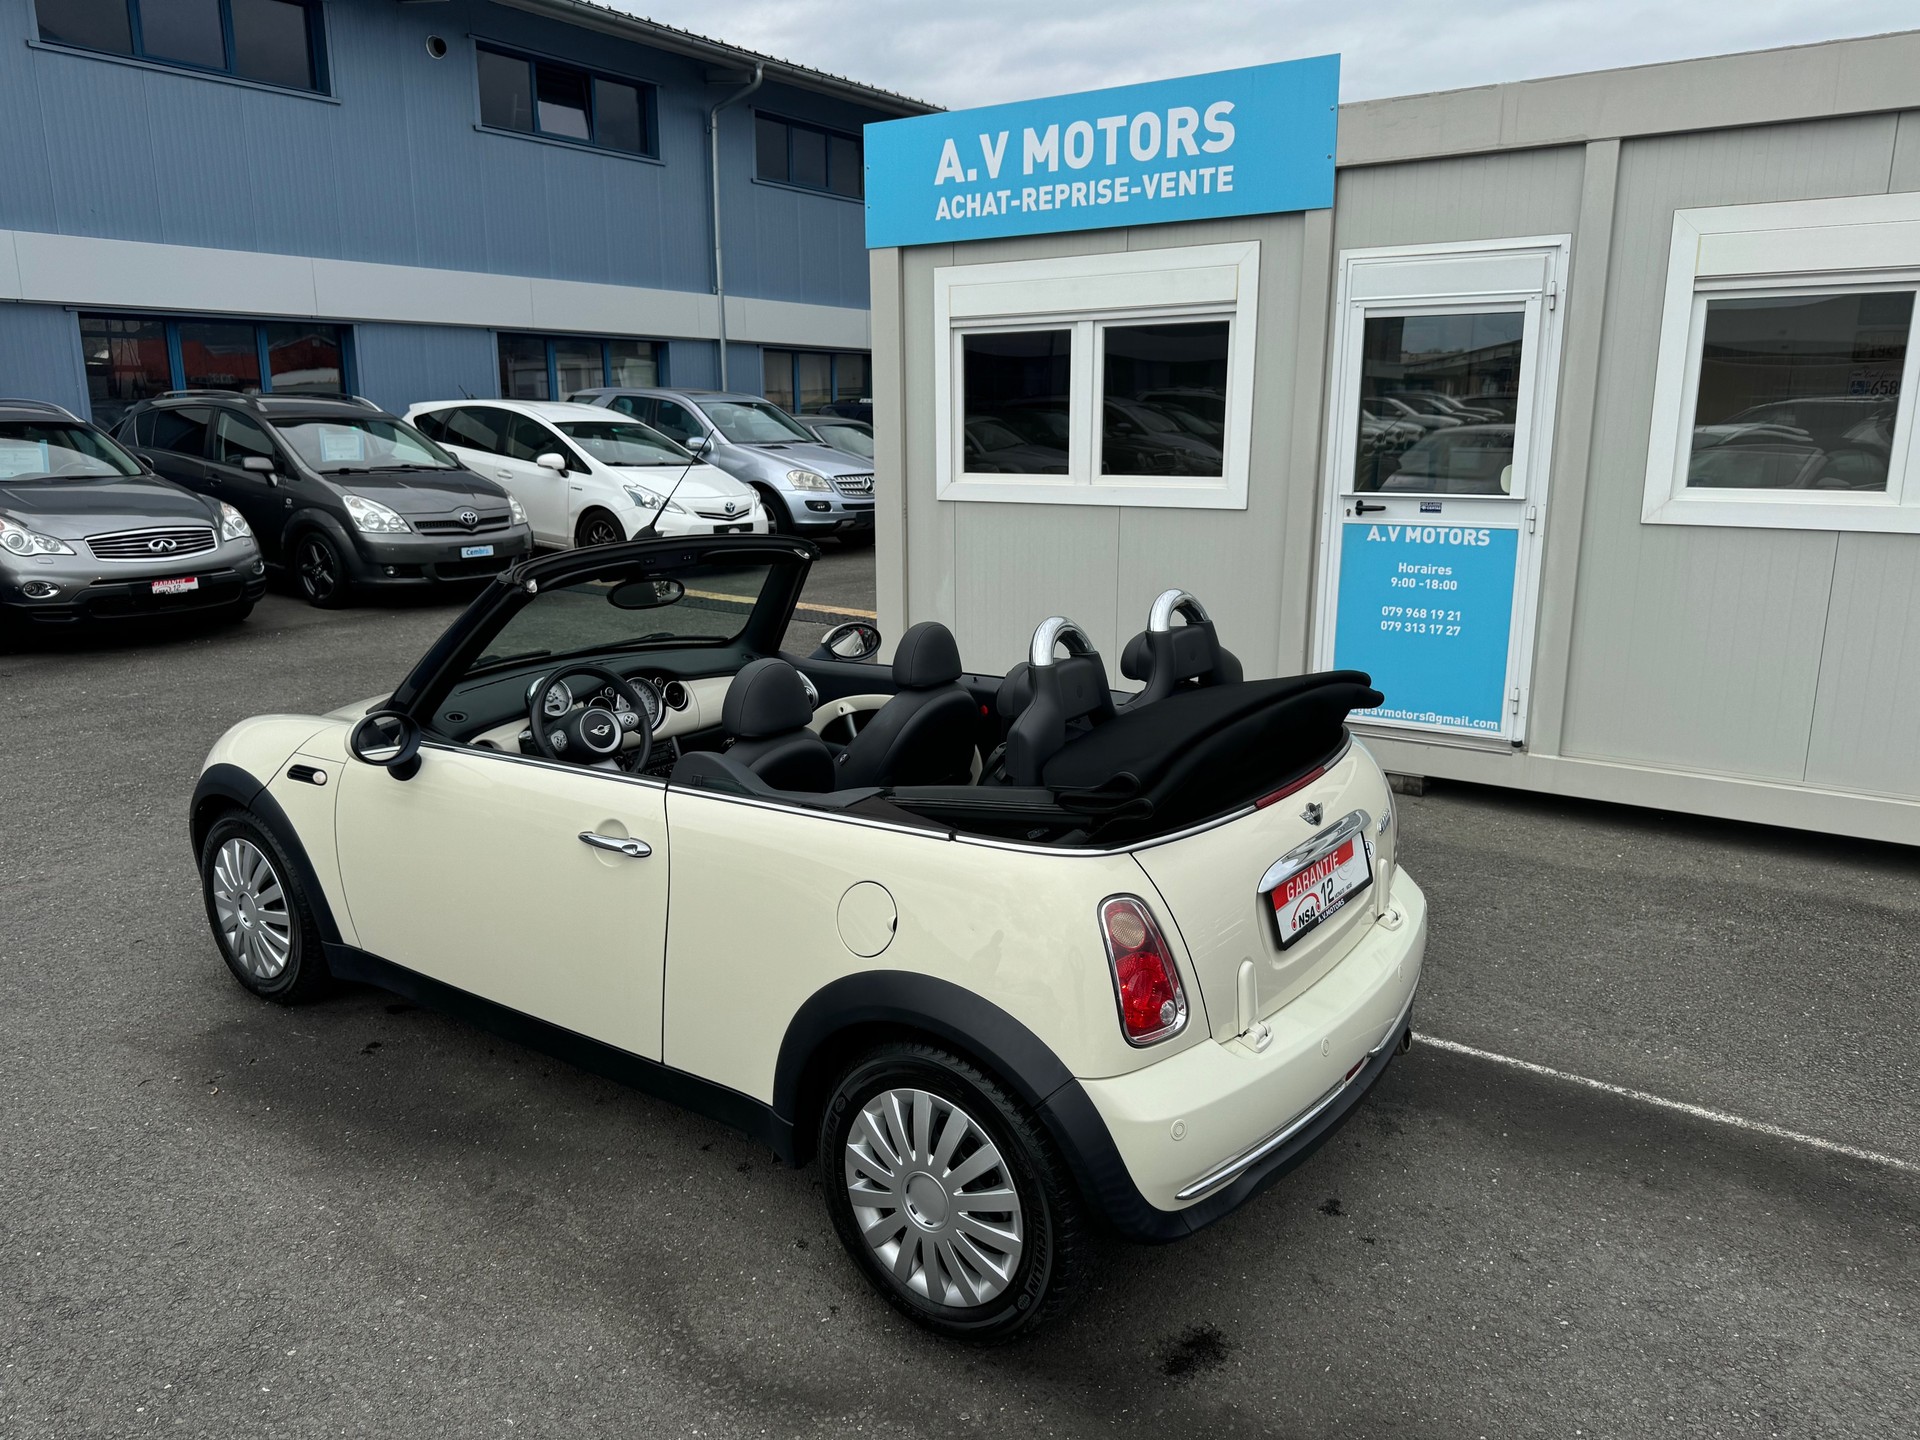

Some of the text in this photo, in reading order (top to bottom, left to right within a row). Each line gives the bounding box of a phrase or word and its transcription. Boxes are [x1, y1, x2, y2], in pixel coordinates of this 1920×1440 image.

[934, 101, 1235, 185] A.V MOTORS
[935, 165, 1234, 221] ACHAT-REPRISE-VENTE
[1366, 525, 1491, 546] A.V MOTORS
[1398, 562, 1452, 575] Horaires
[1390, 577, 1416, 588] 9:00
[1381, 606, 1461, 621] 079 968 19 21
[1380, 620, 1461, 636] 079 313 17 27
[1350, 708, 1498, 730] ageavmotors@gmail.com
[1286, 850, 1339, 901] GARANTIE
[1320, 877, 1335, 907] 12
[1298, 905, 1316, 928] NSA
